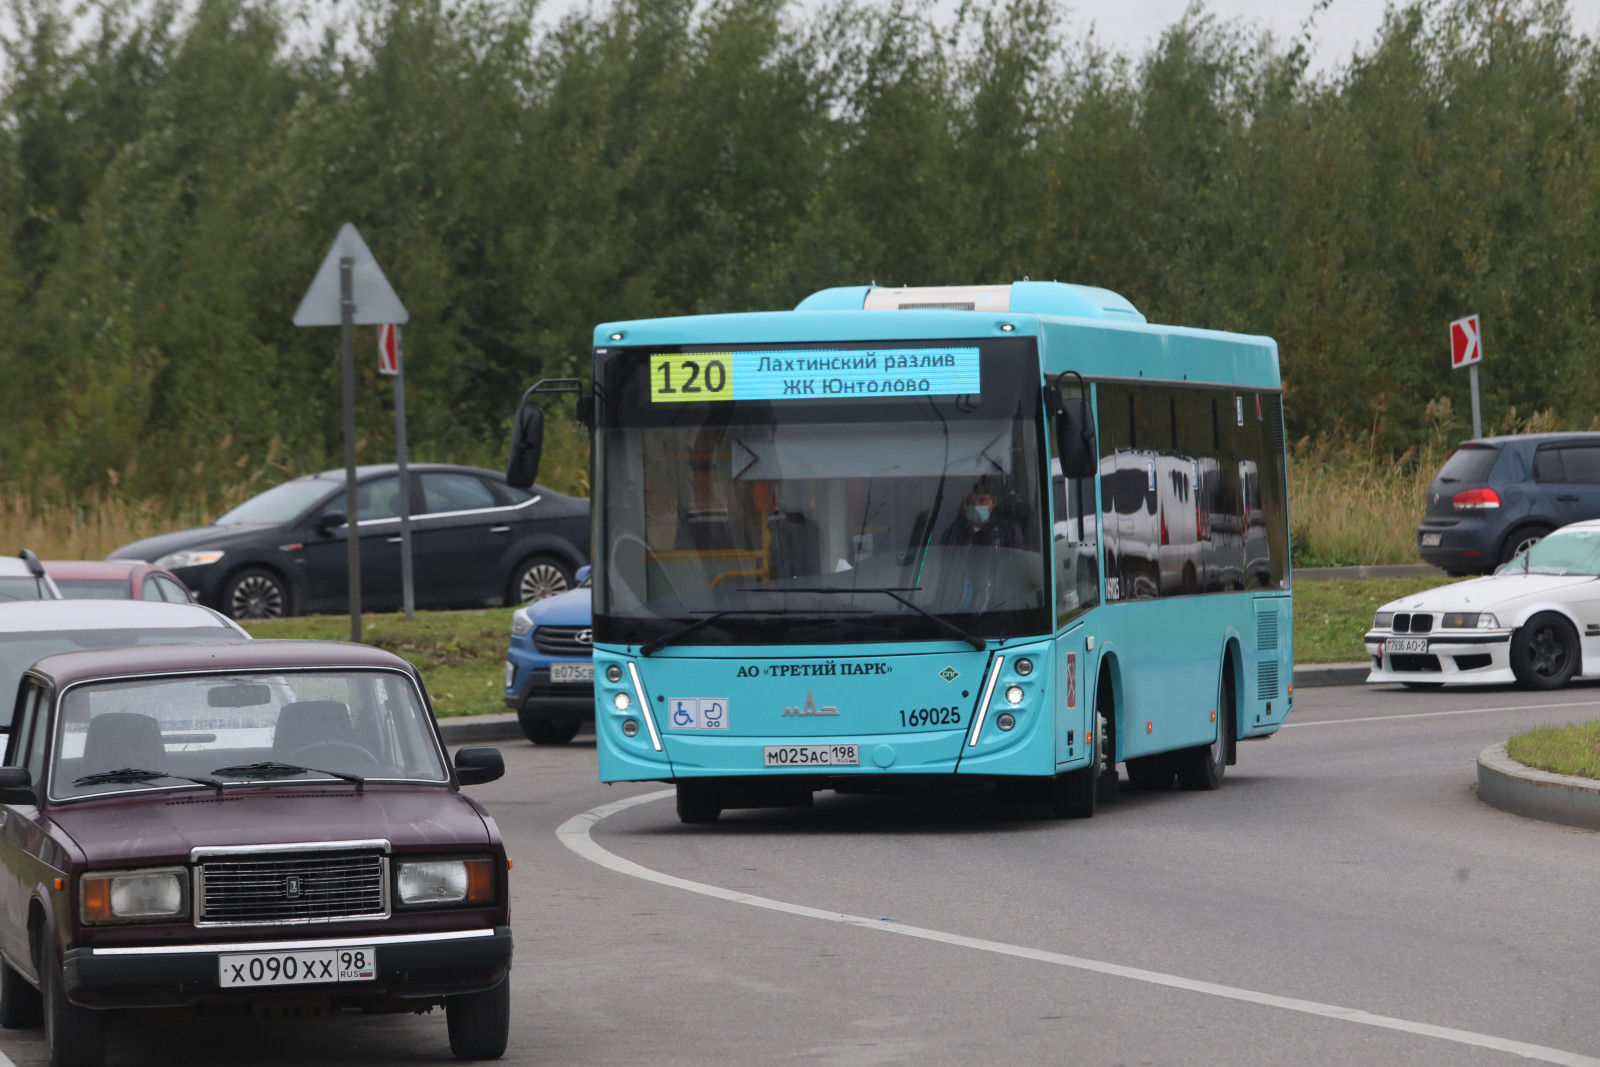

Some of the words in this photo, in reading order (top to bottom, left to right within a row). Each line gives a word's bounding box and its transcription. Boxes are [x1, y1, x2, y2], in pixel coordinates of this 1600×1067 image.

[756, 352, 877, 372] Лахтинский
[884, 353, 955, 371] разлив
[657, 360, 727, 394] 120
[783, 379, 814, 395] ЖК
[822, 378, 930, 395] Юнтолово
[736, 665, 760, 678] АО
[763, 660, 837, 677] «ТРЕТИЙ
[840, 662, 893, 676] ПАРК»
[900, 706, 961, 728] 169025
[768, 748, 829, 764] М025АС
[832, 746, 855, 758] 198
[231, 956, 333, 983] Х090ХХ
[340, 951, 366, 970] 98
[340, 970, 359, 978] RUS
